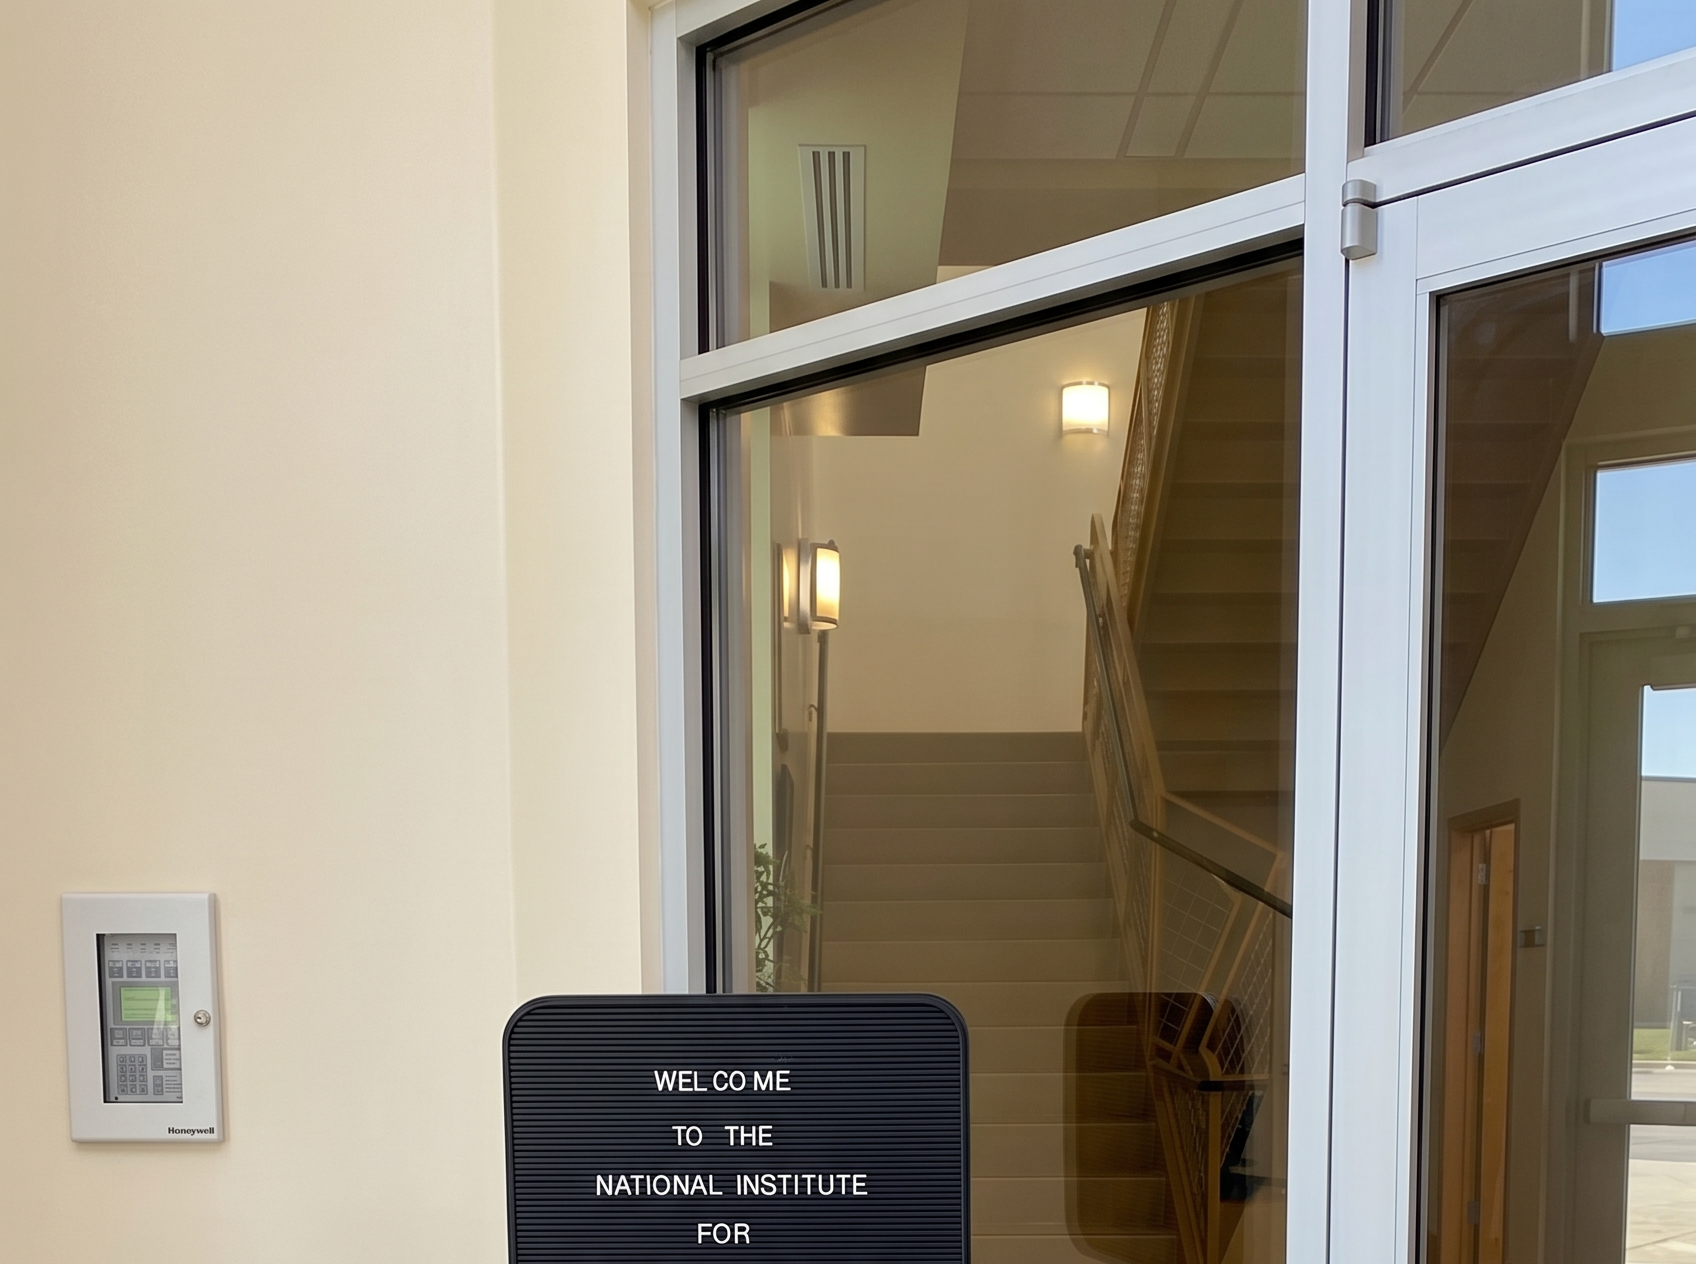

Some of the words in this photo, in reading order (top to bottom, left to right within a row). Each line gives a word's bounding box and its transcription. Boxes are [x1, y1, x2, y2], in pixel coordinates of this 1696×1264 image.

[654, 1070, 791, 1092] WELCOME
[168, 1127, 215, 1136] Honeywell
[672, 1125, 703, 1147] TO
[724, 1125, 773, 1147] THE
[596, 1174, 723, 1196] NATIONAL
[736, 1173, 868, 1196] INSTITUTE
[697, 1222, 750, 1245] FOR
